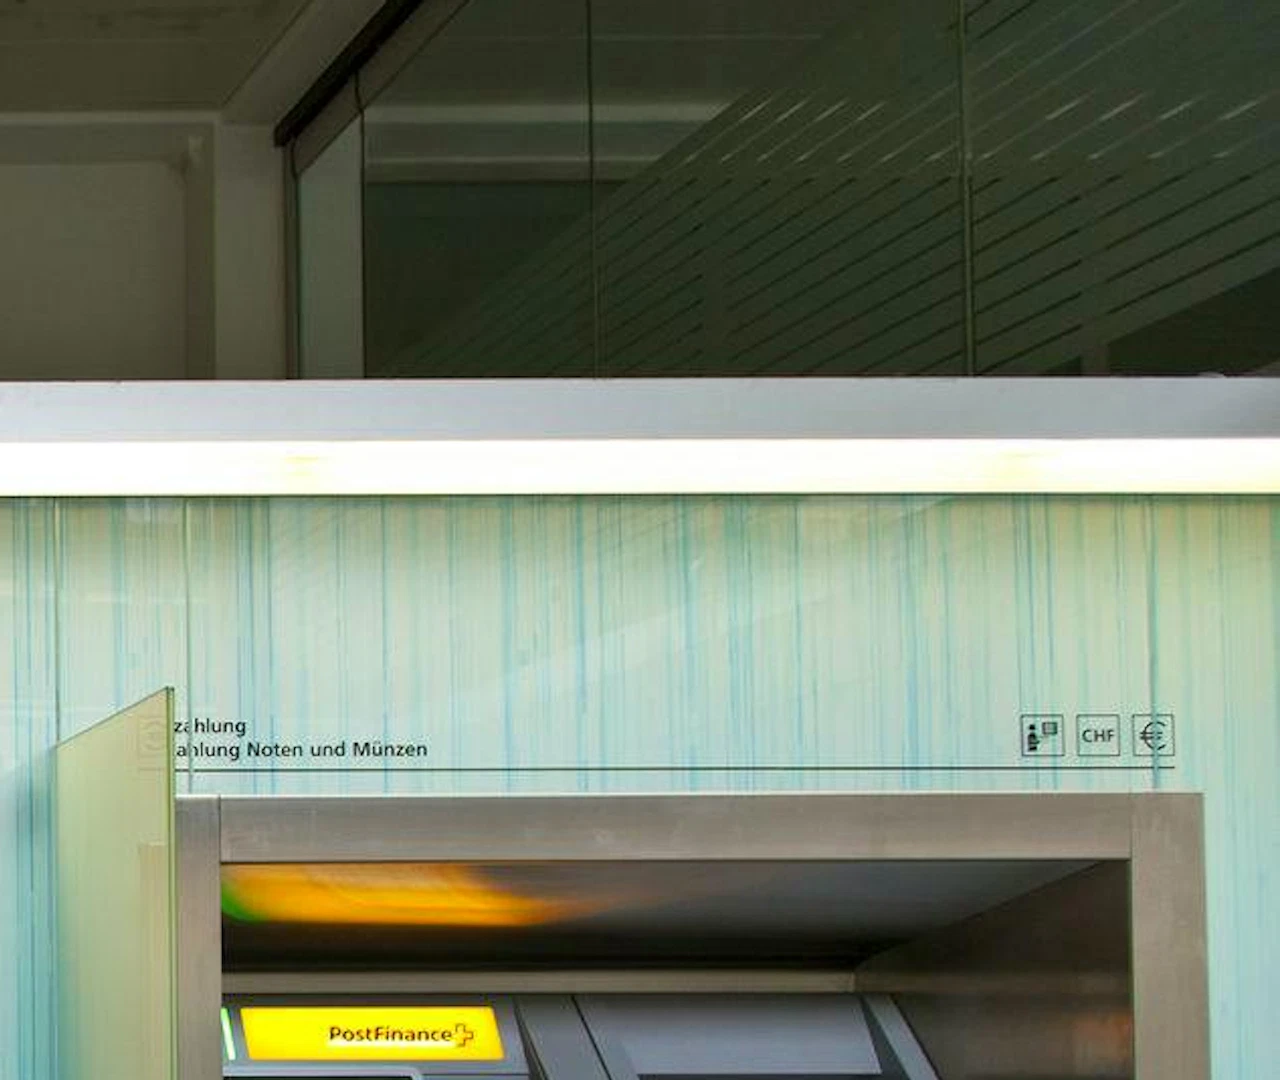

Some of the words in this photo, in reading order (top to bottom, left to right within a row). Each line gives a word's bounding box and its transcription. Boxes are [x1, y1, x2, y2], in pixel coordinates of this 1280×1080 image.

[174, 718, 247, 737] zahlung
[1082, 728, 1116, 744] CHF
[176, 740, 241, 762] ahlung
[246, 742, 303, 758] Noten
[310, 740, 346, 757] und
[352, 740, 428, 758] Münzen
[329, 1025, 452, 1043] PostFinance
